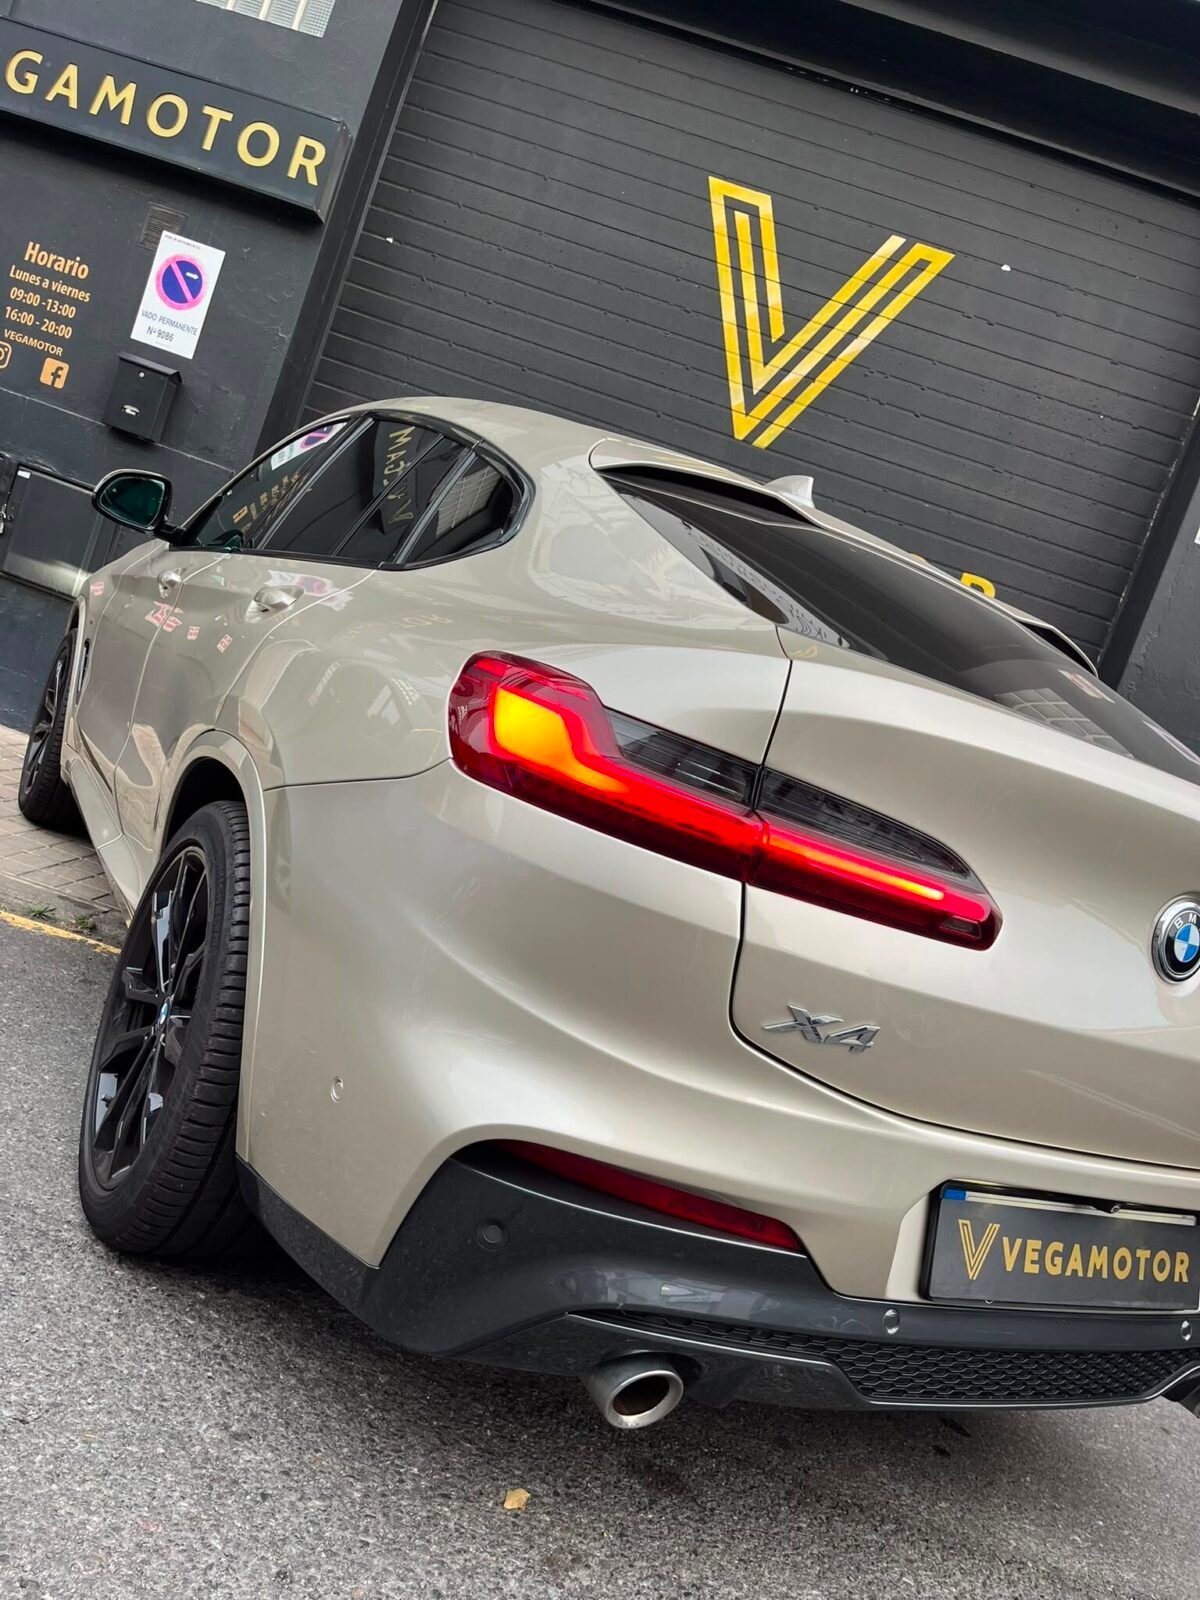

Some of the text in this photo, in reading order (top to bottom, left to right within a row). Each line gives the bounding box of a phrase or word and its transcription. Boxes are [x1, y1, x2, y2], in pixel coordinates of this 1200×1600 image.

[5, 49, 327, 186] GAMOTOR
[24, 241, 90, 280] Horario
[9, 265, 91, 302] Lunes a viernes
[10, 287, 41, 307] 09:00
[5, 307, 35, 326] 16:00
[41, 319, 73, 339] 20:00
[141, 309, 199, 336] VADO PERMANENTE
[4, 329, 63, 357] VEGAMOTOR
[1174, 913, 1200, 932] BM
[762, 1003, 881, 1053] X4
[1003, 1236, 1189, 1283] VEGAMOTOR
